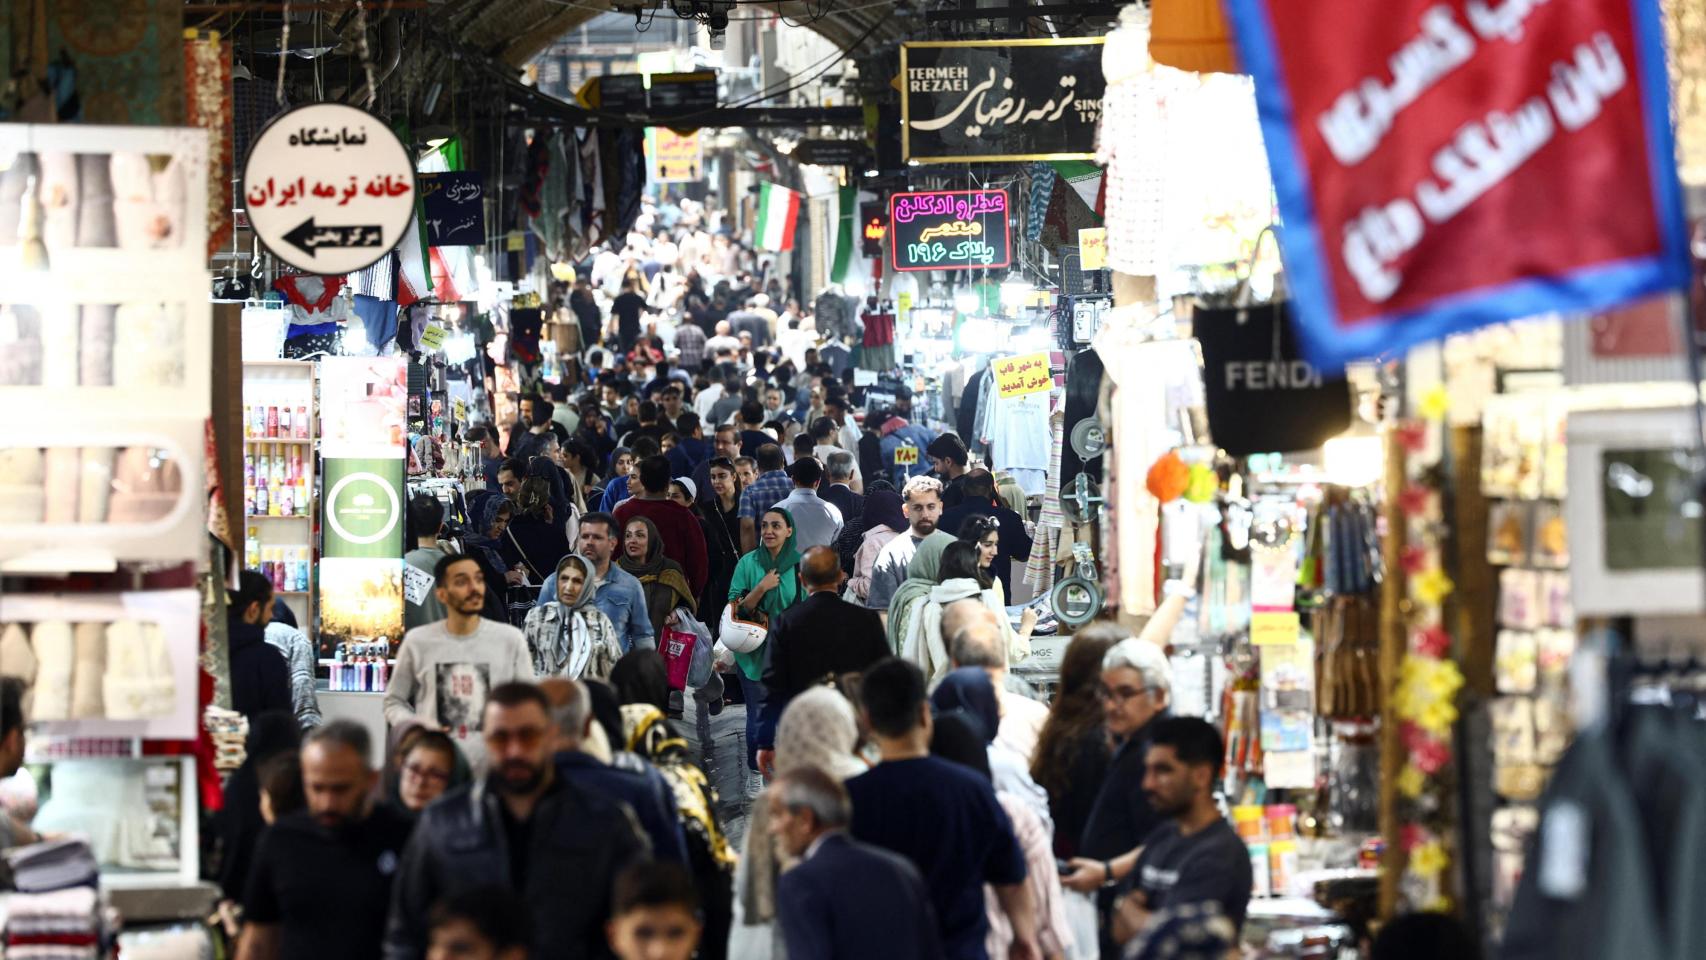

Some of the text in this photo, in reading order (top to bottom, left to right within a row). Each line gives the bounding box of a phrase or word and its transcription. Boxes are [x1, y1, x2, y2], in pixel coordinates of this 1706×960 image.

[908, 67, 969, 80] TERMEH
[1547, 30, 1627, 131] نان
[910, 80, 969, 92] REZAEI
[1022, 75, 1077, 124] ترمه
[1073, 99, 1103, 111] SINC
[1080, 111, 1103, 123] 19
[288, 126, 367, 151] نمایشگاه
[1415, 96, 1555, 224] سنگک
[247, 175, 305, 207] ایران
[311, 176, 358, 206] ترمه
[364, 174, 411, 198] خانه
[895, 193, 1004, 223] عطر و ادکلن
[304, 227, 379, 247] مرکز پخش
[908, 241, 995, 265] پلاک ۱۹۶
[1001, 374, 1049, 393] خوش آمدید
